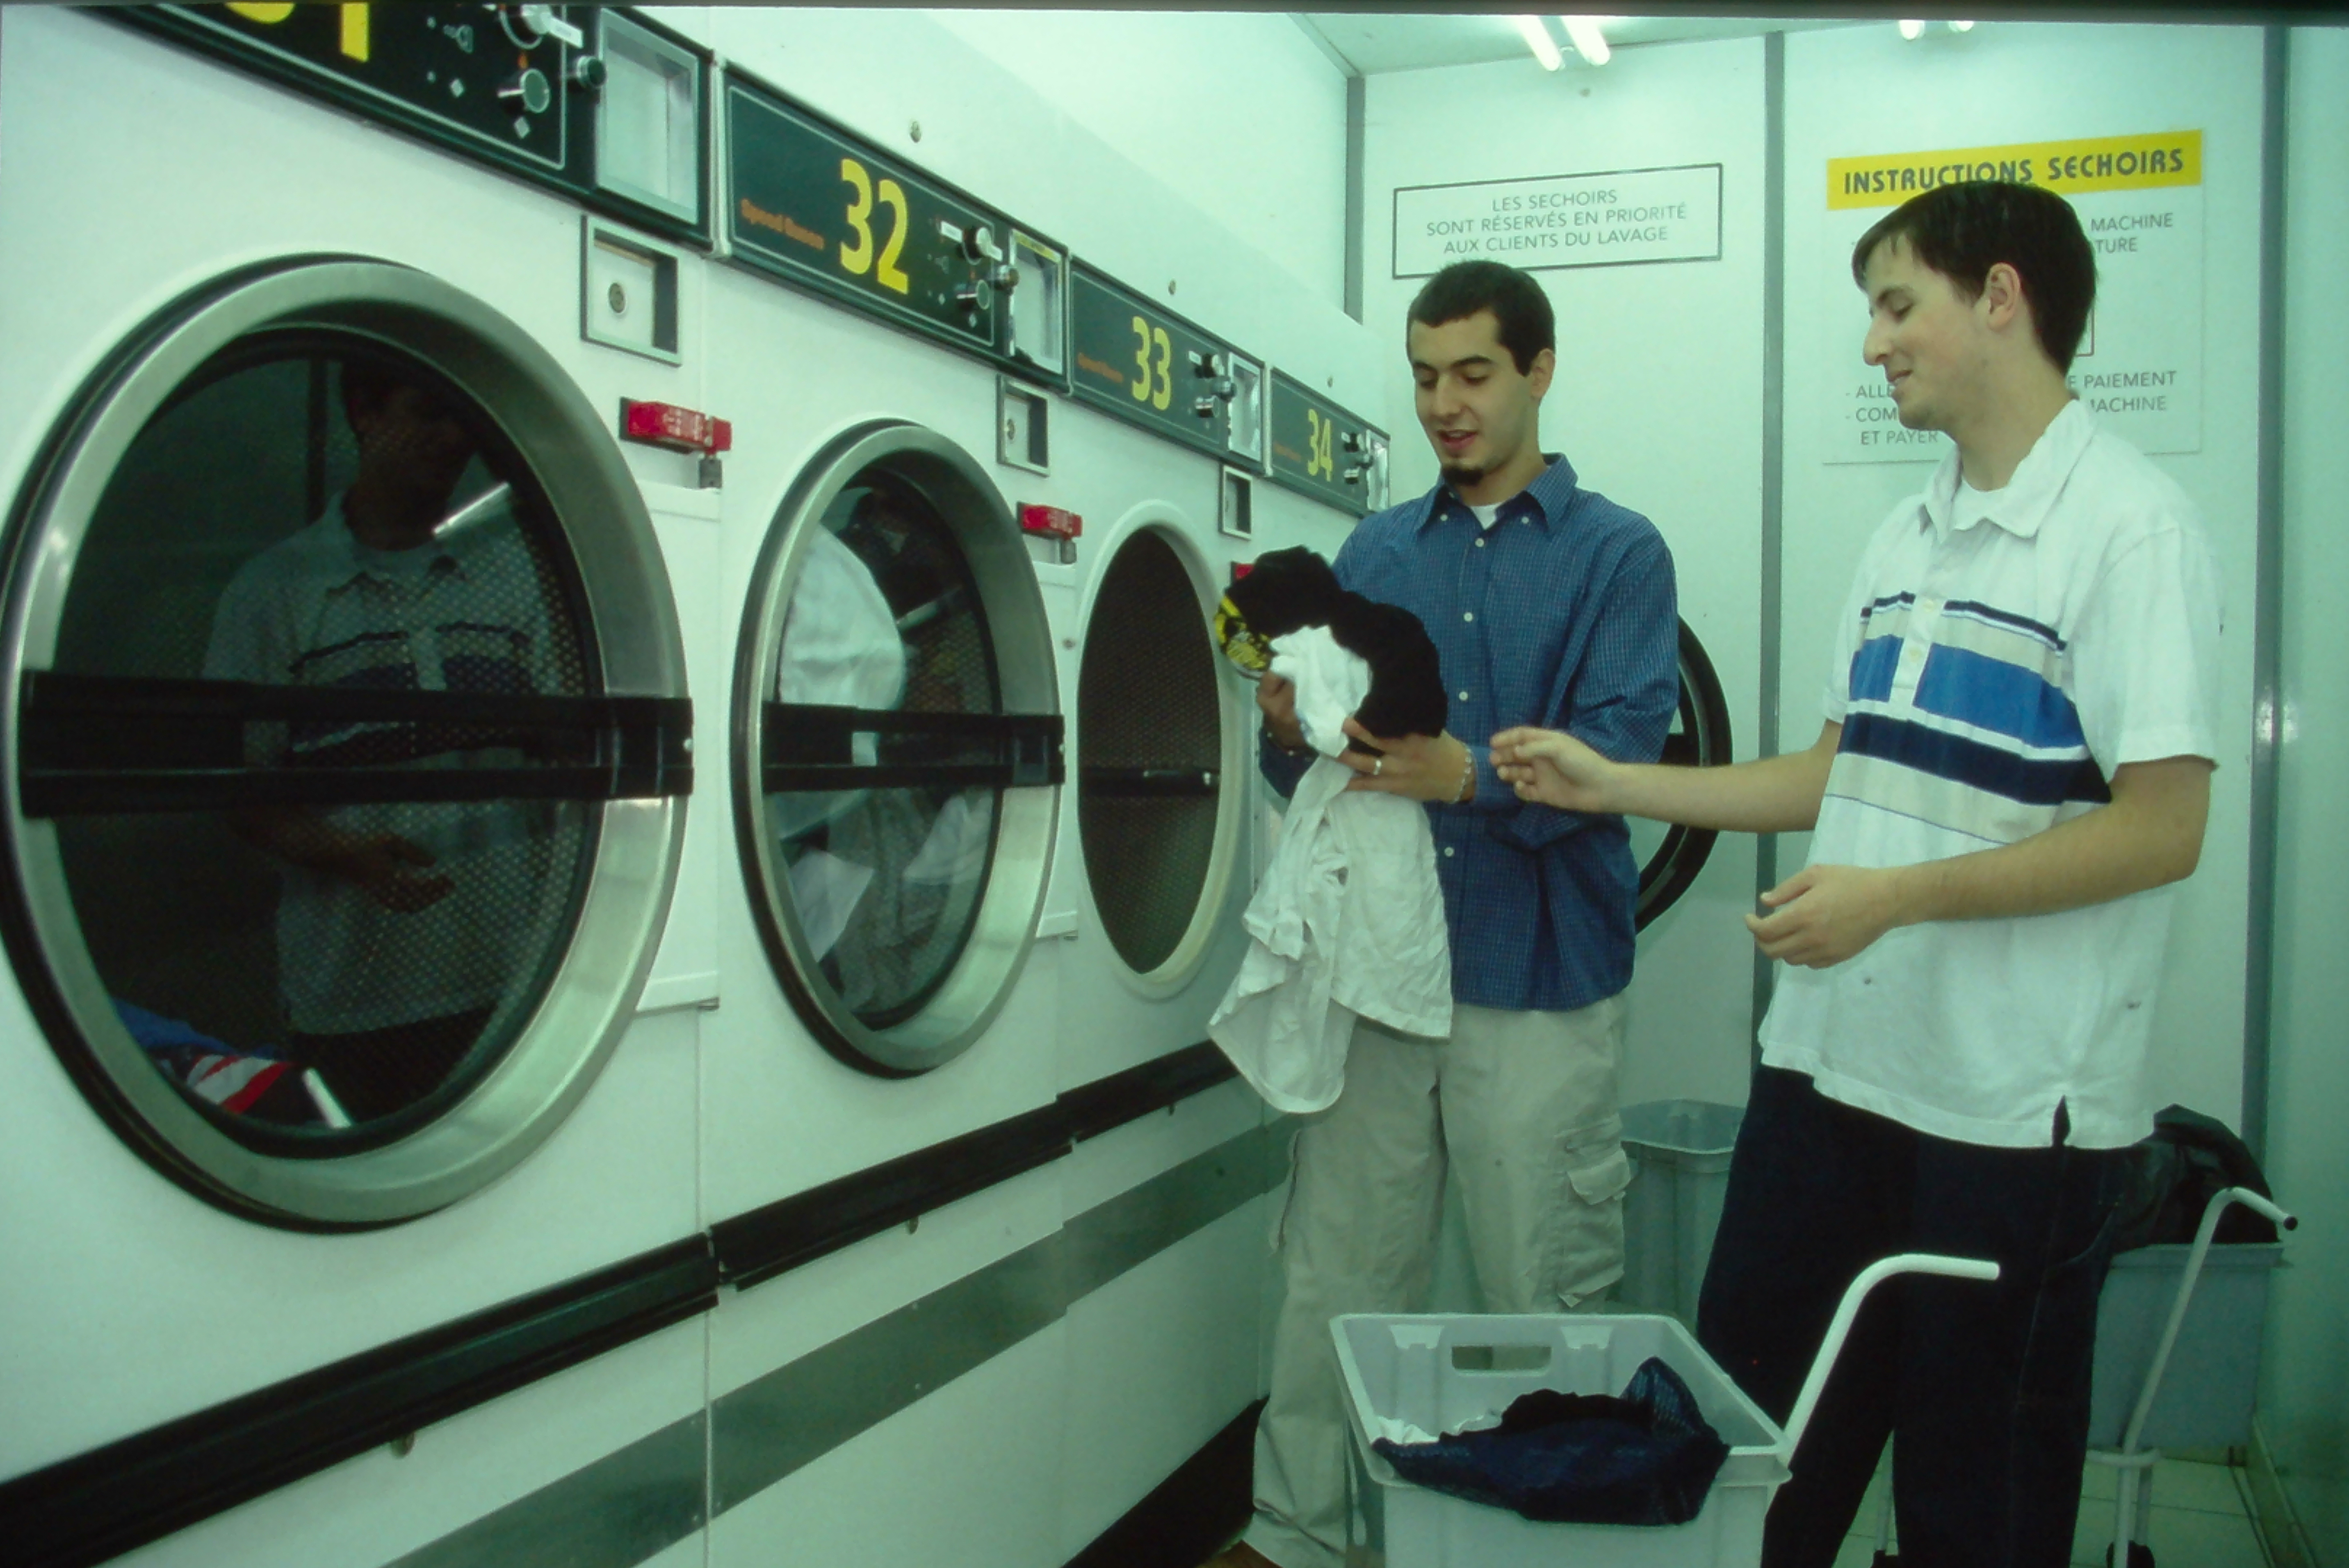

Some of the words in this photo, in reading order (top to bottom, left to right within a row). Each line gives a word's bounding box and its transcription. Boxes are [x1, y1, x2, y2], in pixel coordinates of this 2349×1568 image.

[1844, 159, 2032, 194] INSTRUCTIONS
[2047, 148, 2184, 180] SECHOIRS
[1492, 196, 1522, 212] LES
[1528, 189, 1617, 209] SECHOIRS
[840, 158, 908, 295] 32
[1427, 219, 1474, 237] SONT
[1482, 211, 1567, 231] RÉSERVÉS
[1574, 211, 1598, 226] EN
[1606, 202, 1686, 222] PRIORITÉ
[2091, 212, 2173, 232] MACHINE
[1444, 239, 1479, 254] AUX
[1486, 233, 1558, 251] CLIENTS
[1564, 232, 1590, 246] DU
[1599, 226, 1668, 244] LAVAGE
[1131, 316, 1172, 410] 33
[2084, 371, 2177, 388] PAIEMENT
[1307, 408, 1333, 481] 34
[1861, 431, 1880, 445] ET
[1886, 430, 1938, 444] PAYER
